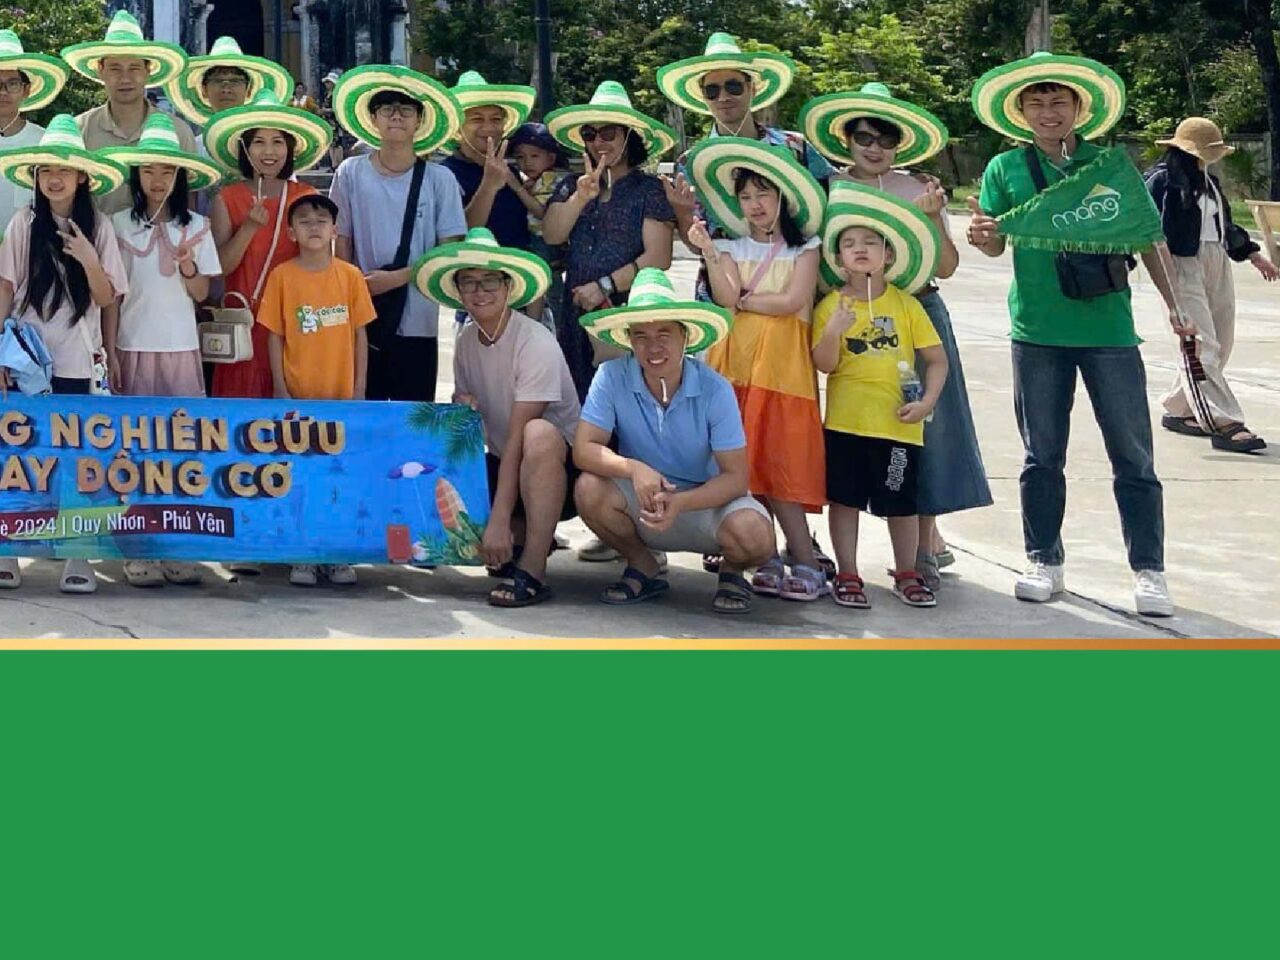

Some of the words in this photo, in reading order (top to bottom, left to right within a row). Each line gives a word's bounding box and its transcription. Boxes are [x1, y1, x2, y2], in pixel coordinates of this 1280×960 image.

[1051, 197, 1119, 230] mang
[50, 407, 230, 452] NGHIÊN
[246, 410, 346, 455] CỨU
[227, 460, 294, 498] CƠ
[14, 517, 57, 536] 2024
[71, 515, 102, 537] Quy
[107, 512, 145, 531] Nhơn
[163, 510, 191, 531] Phú
[196, 512, 225, 534] Yên
